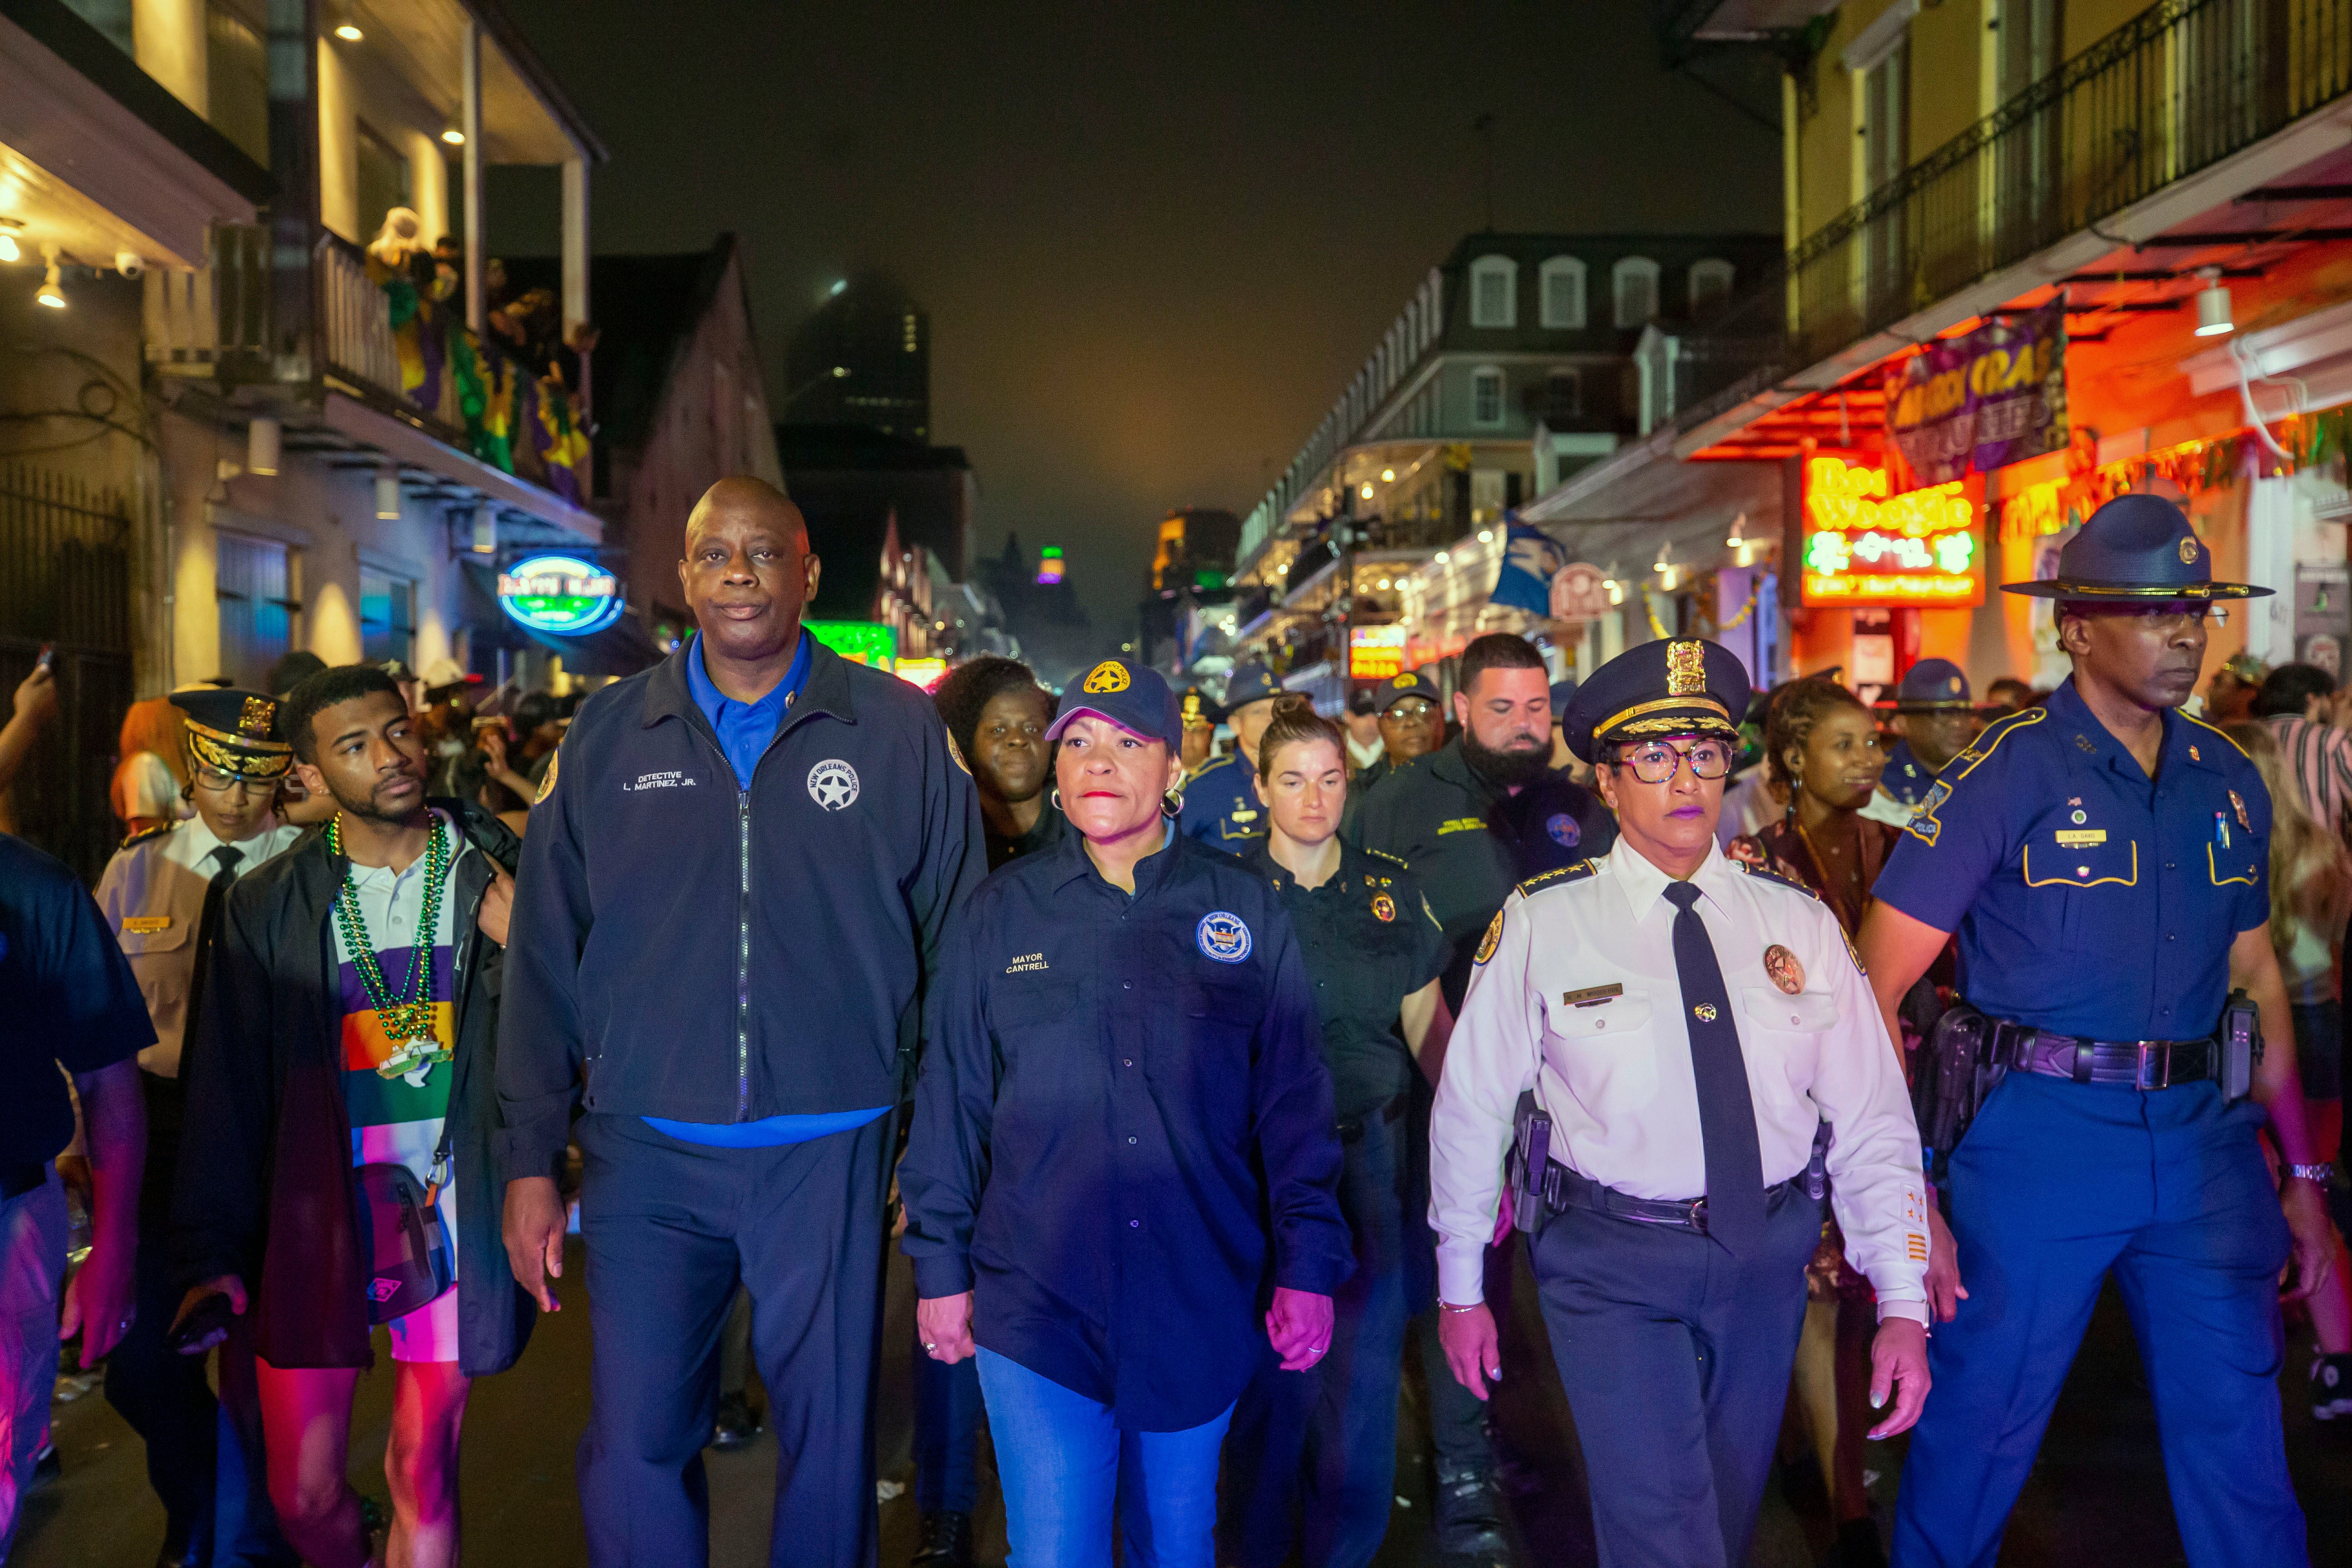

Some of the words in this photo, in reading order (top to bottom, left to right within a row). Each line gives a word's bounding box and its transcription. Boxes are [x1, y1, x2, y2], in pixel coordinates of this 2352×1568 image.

[637, 771, 682, 783] DETECTIVE
[809, 773, 819, 788] NEW
[816, 763, 847, 775] ORLEANS
[845, 769, 858, 792] POLICE
[634, 779, 678, 791] MARTINEZ,
[1012, 953, 1043, 964] MAYOR
[1006, 960, 1049, 974] CANTRELL
